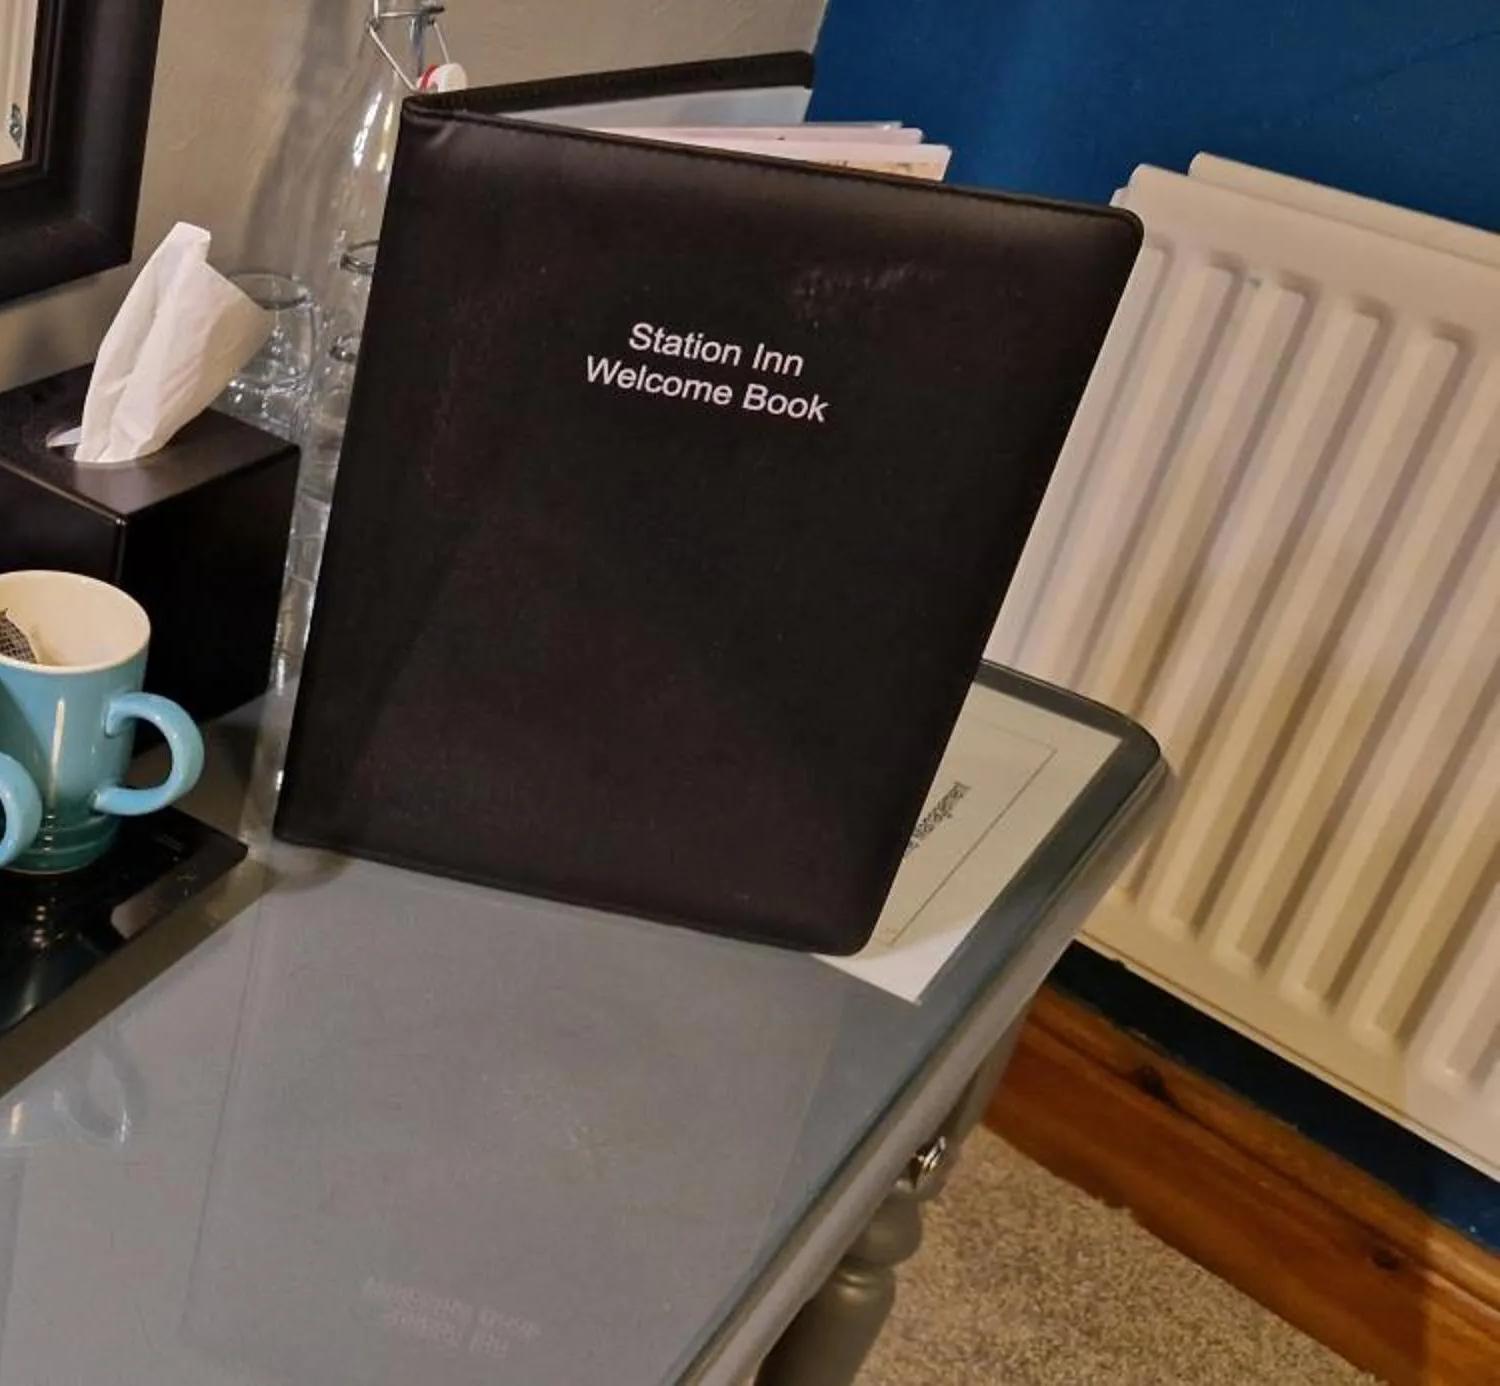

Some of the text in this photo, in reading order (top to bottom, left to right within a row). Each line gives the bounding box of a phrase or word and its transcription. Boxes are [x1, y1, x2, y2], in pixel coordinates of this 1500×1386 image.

[628, 322, 805, 377] Station Inn
[586, 355, 830, 423] Welcome Book
